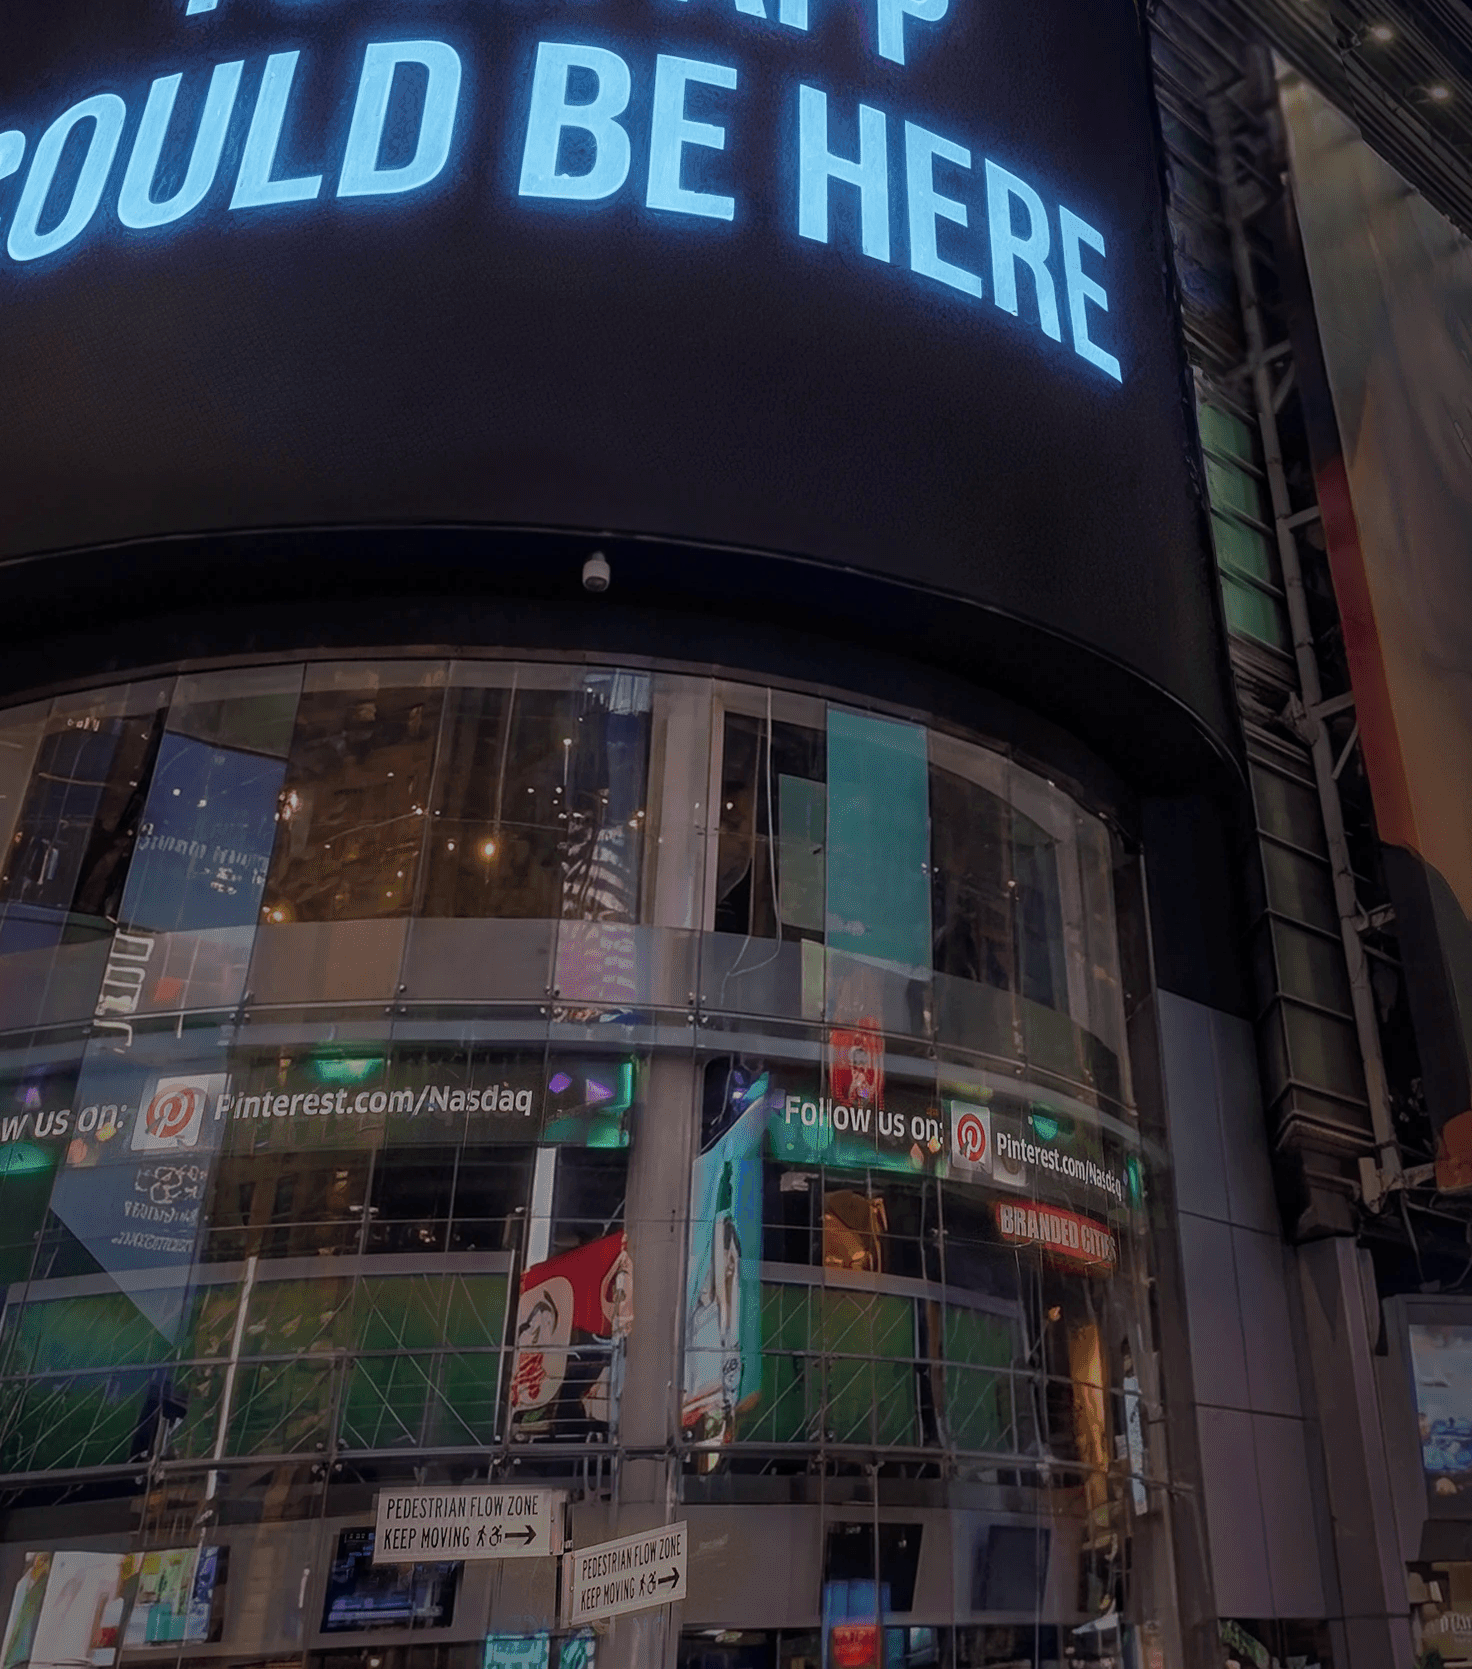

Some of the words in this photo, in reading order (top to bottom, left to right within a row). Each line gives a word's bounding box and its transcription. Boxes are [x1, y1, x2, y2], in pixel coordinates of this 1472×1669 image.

[517, 40, 740, 223] BE
[795, 81, 1126, 387] HERE
[34, 1106, 71, 1137] us
[76, 1099, 129, 1135] on:
[212, 1079, 534, 1122] Pinterest.com/Nasdaq
[784, 1094, 872, 1135] Follow
[877, 1109, 906, 1138] us
[909, 1114, 945, 1146] on:
[995, 1130, 1125, 1203] Pinterest.com/Nasdaq
[998, 1200, 1080, 1251] BRANDED
[385, 1495, 467, 1521] PEDESTRIAN
[469, 1494, 504, 1518] FLOW
[506, 1494, 540, 1517] ZONE
[382, 1526, 417, 1551] KEEP
[419, 1525, 471, 1550] MOVING
[580, 1546, 633, 1582] PEDESTRIAN
[632, 1539, 658, 1568] FLOW
[658, 1533, 683, 1562] ZONE
[579, 1585, 603, 1613] KEEP
[602, 1576, 637, 1607] MOVING
